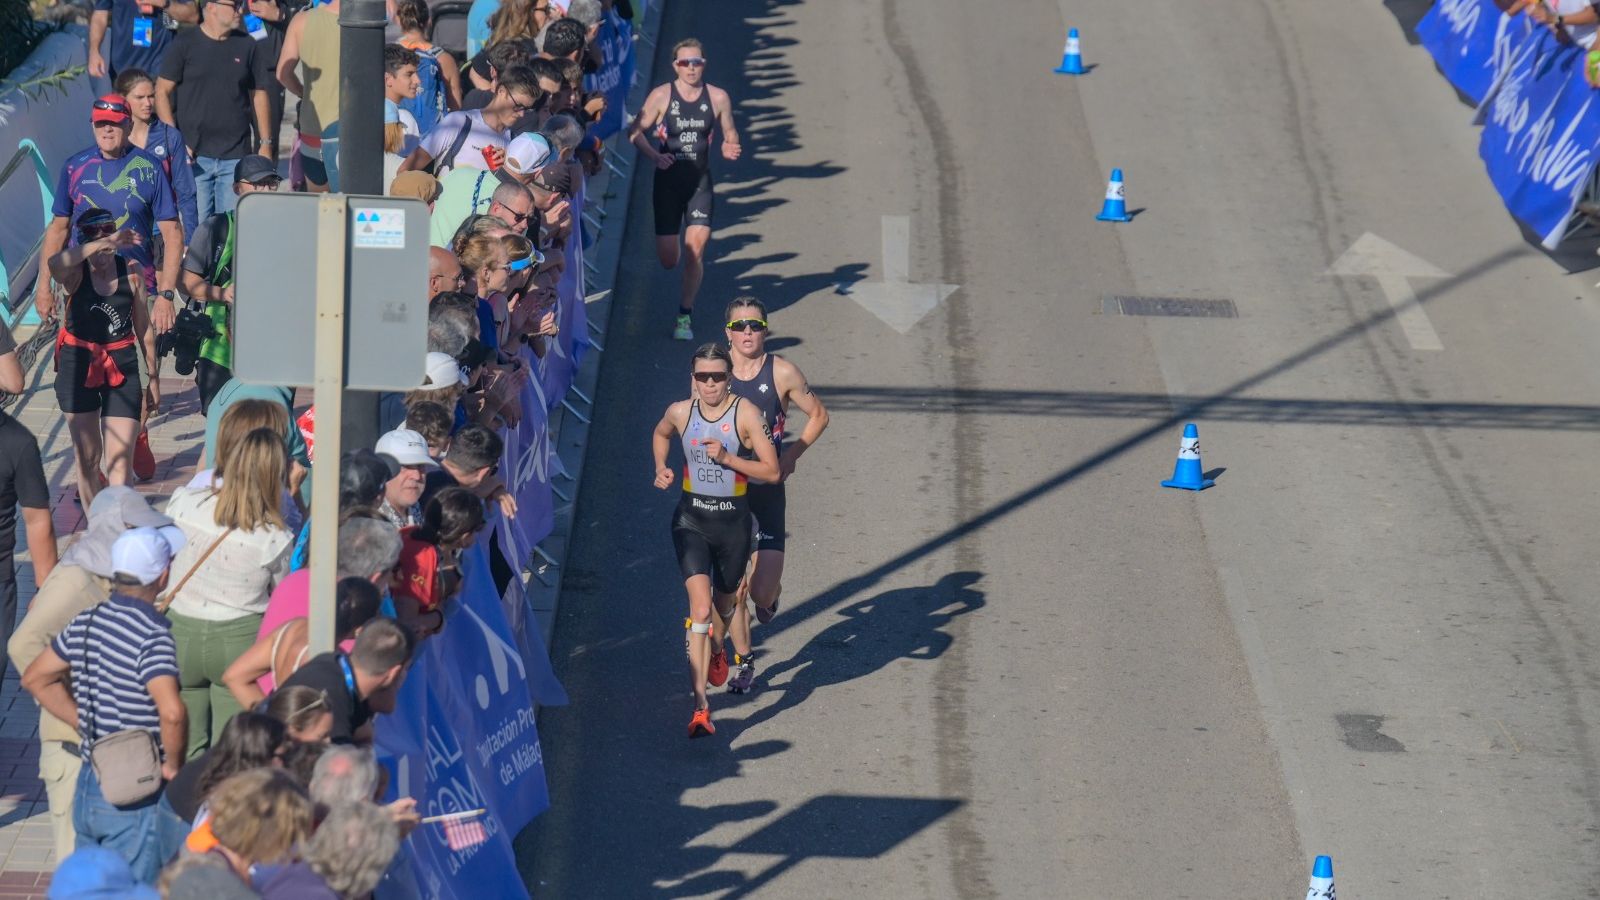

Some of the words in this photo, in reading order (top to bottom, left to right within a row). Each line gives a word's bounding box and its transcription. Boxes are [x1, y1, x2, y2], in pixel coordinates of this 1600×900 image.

[680, 131, 698, 143] GBR
[690, 449, 715, 465] NEUB
[697, 467, 724, 484] GER
[500, 762, 515, 786] de
